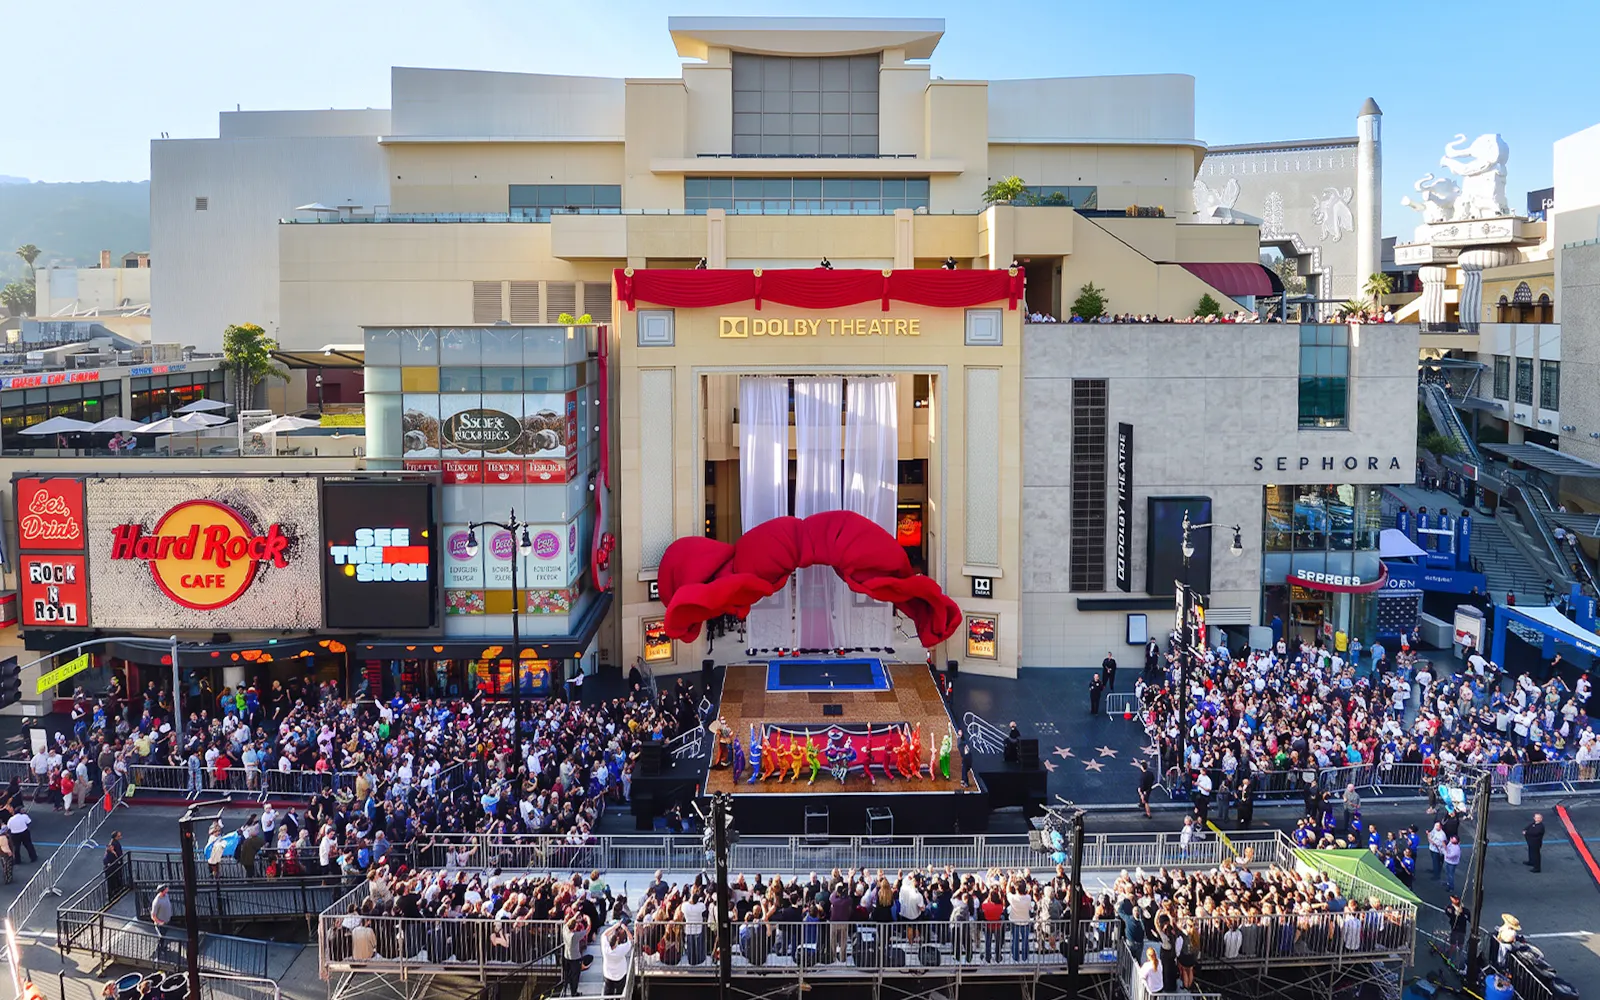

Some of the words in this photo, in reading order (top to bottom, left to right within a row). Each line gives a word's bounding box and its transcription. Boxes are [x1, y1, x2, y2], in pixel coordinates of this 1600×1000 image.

[752, 318, 821, 336] DOLBY
[826, 318, 920, 336] THEATRE
[1119, 433, 1127, 501] THEATRE
[1253, 456, 1401, 471] SEPHORA
[355, 528, 409, 547] SEE
[1118, 506, 1127, 557] DOLBY
[111, 523, 200, 561] Hard
[201, 523, 288, 569] Rock
[330, 546, 383, 565] THE
[30, 562, 76, 584] ROCK
[180, 574, 225, 588] CAFE
